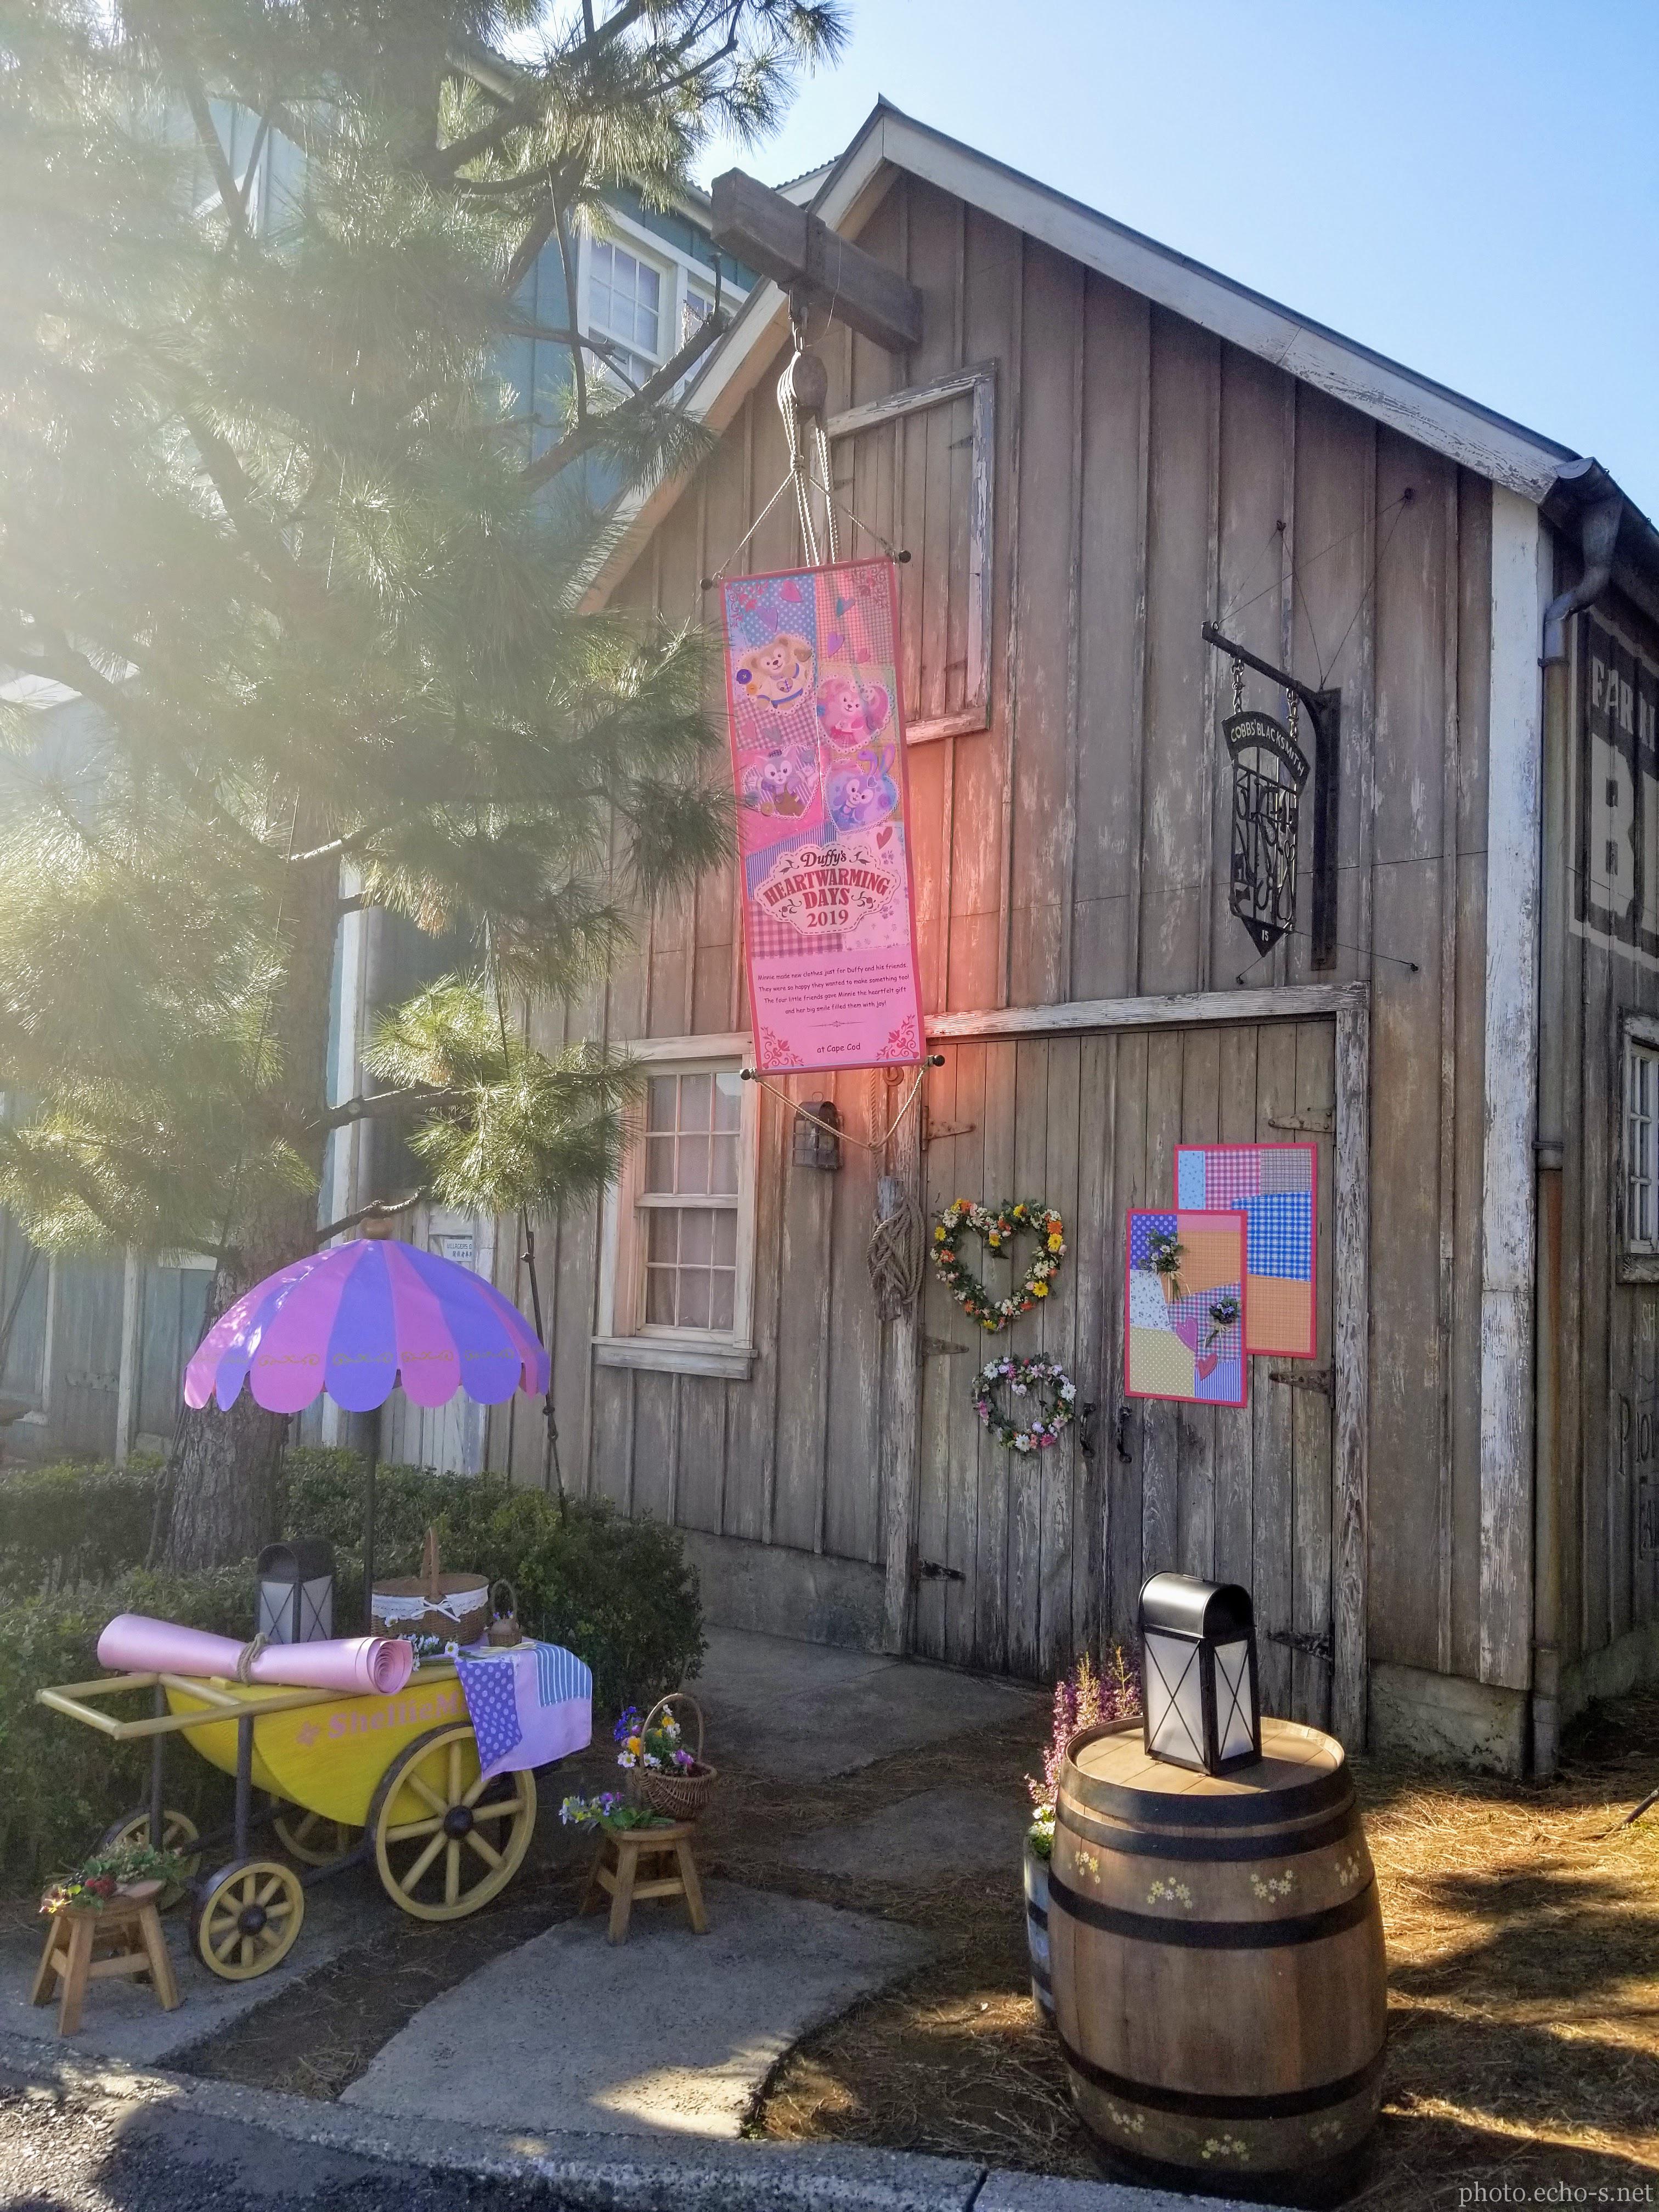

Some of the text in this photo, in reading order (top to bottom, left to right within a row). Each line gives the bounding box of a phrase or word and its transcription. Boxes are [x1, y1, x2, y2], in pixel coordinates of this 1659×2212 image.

[1257, 722, 1304, 776] BLACKSMITH
[800, 848, 847, 867] Duffy's
[763, 868, 890, 906] HEARTWARMING
[802, 888, 850, 910] DAYS
[806, 910, 849, 927] 2019
[1262, 929, 1268, 941] 15
[827, 1045, 845, 1053] Cape
[847, 1042, 861, 1051] Cod
